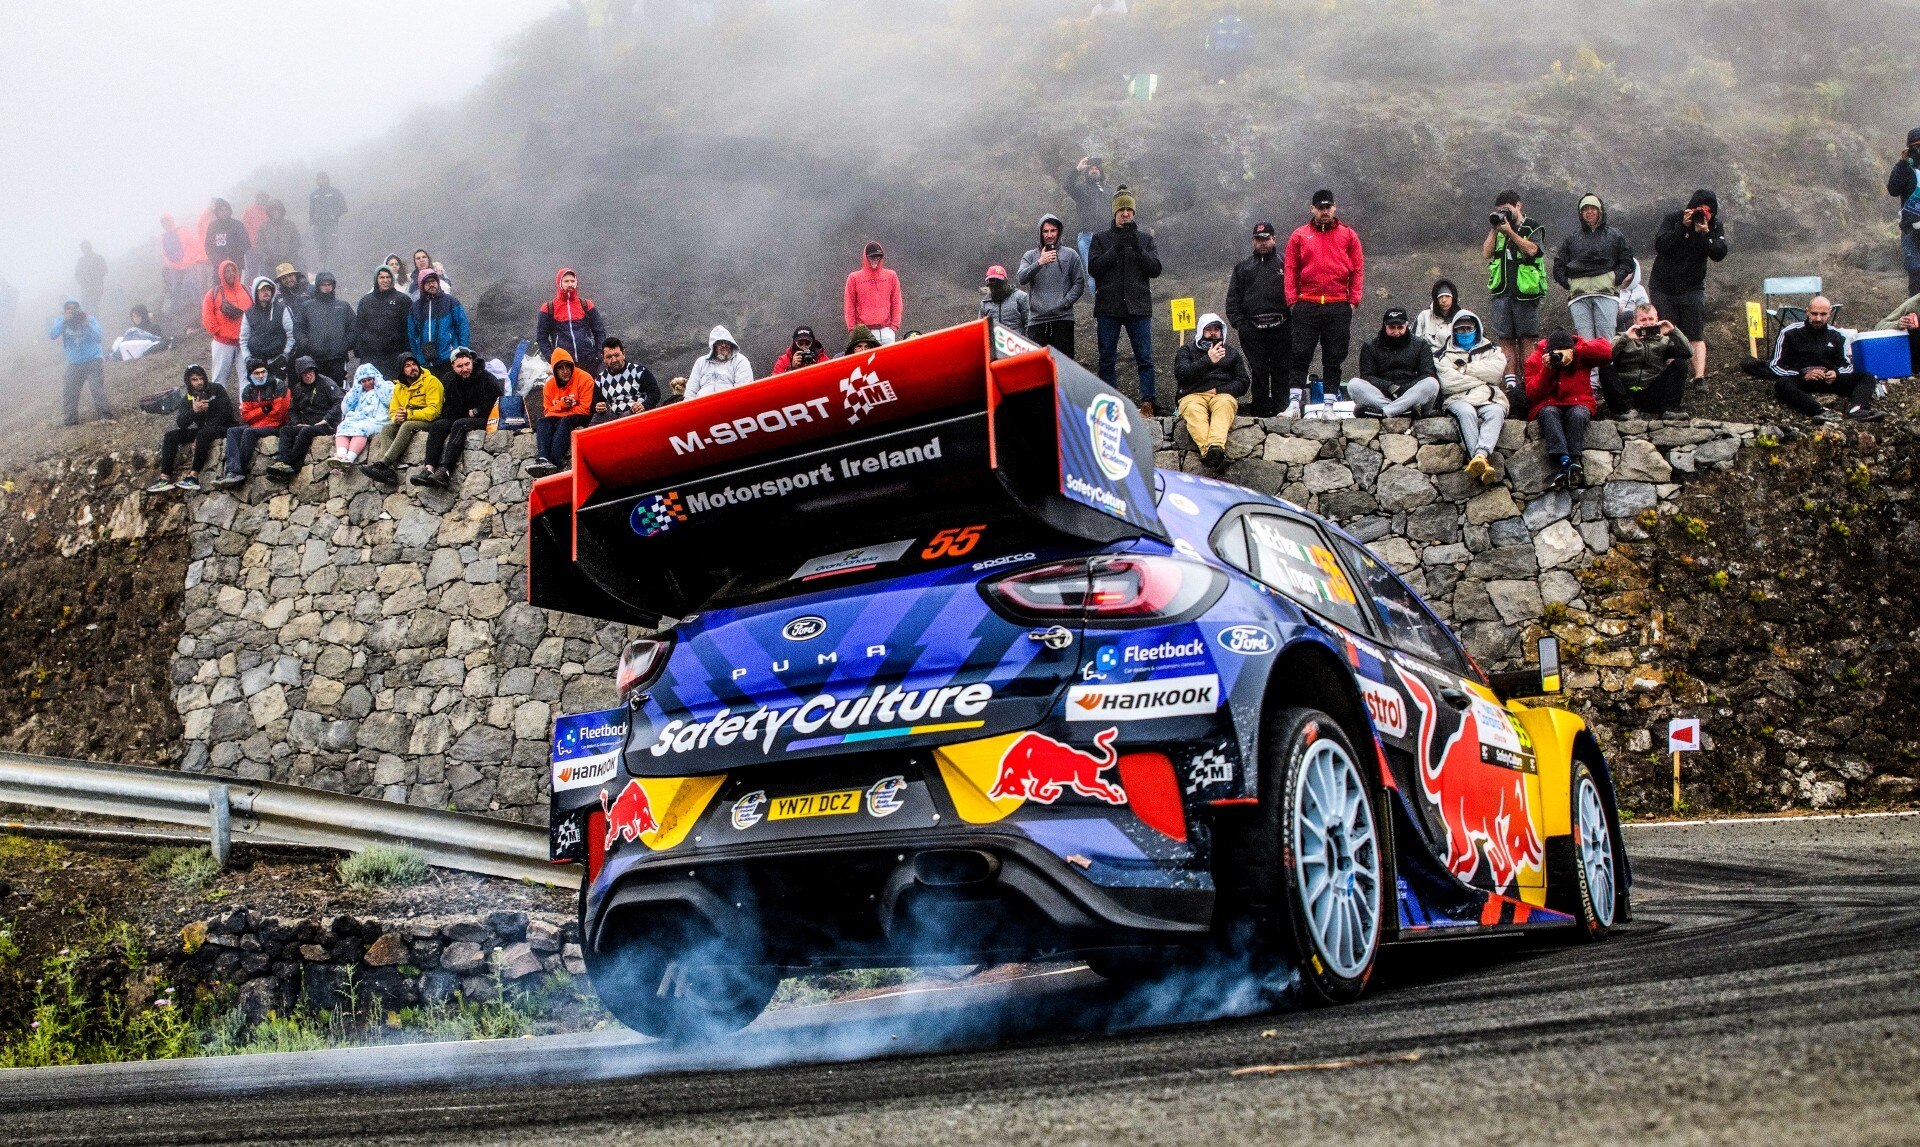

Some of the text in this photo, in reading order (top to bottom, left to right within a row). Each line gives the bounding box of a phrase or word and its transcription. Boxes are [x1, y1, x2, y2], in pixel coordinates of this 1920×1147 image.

[668, 396, 830, 456] M-SPORT
[685, 436, 943, 515] Motorsport Ireland
[1066, 473, 1128, 512] SafetyCulture
[920, 523, 988, 560] 55
[971, 552, 1037, 571] sparco
[791, 620, 816, 637] Ford
[1230, 627, 1269, 651] Ford
[1123, 638, 1204, 663] Fleetback
[580, 721, 629, 741] Fleetback
[650, 682, 993, 757] SafetyCulture
[778, 793, 853, 816] YN71 DCZ
